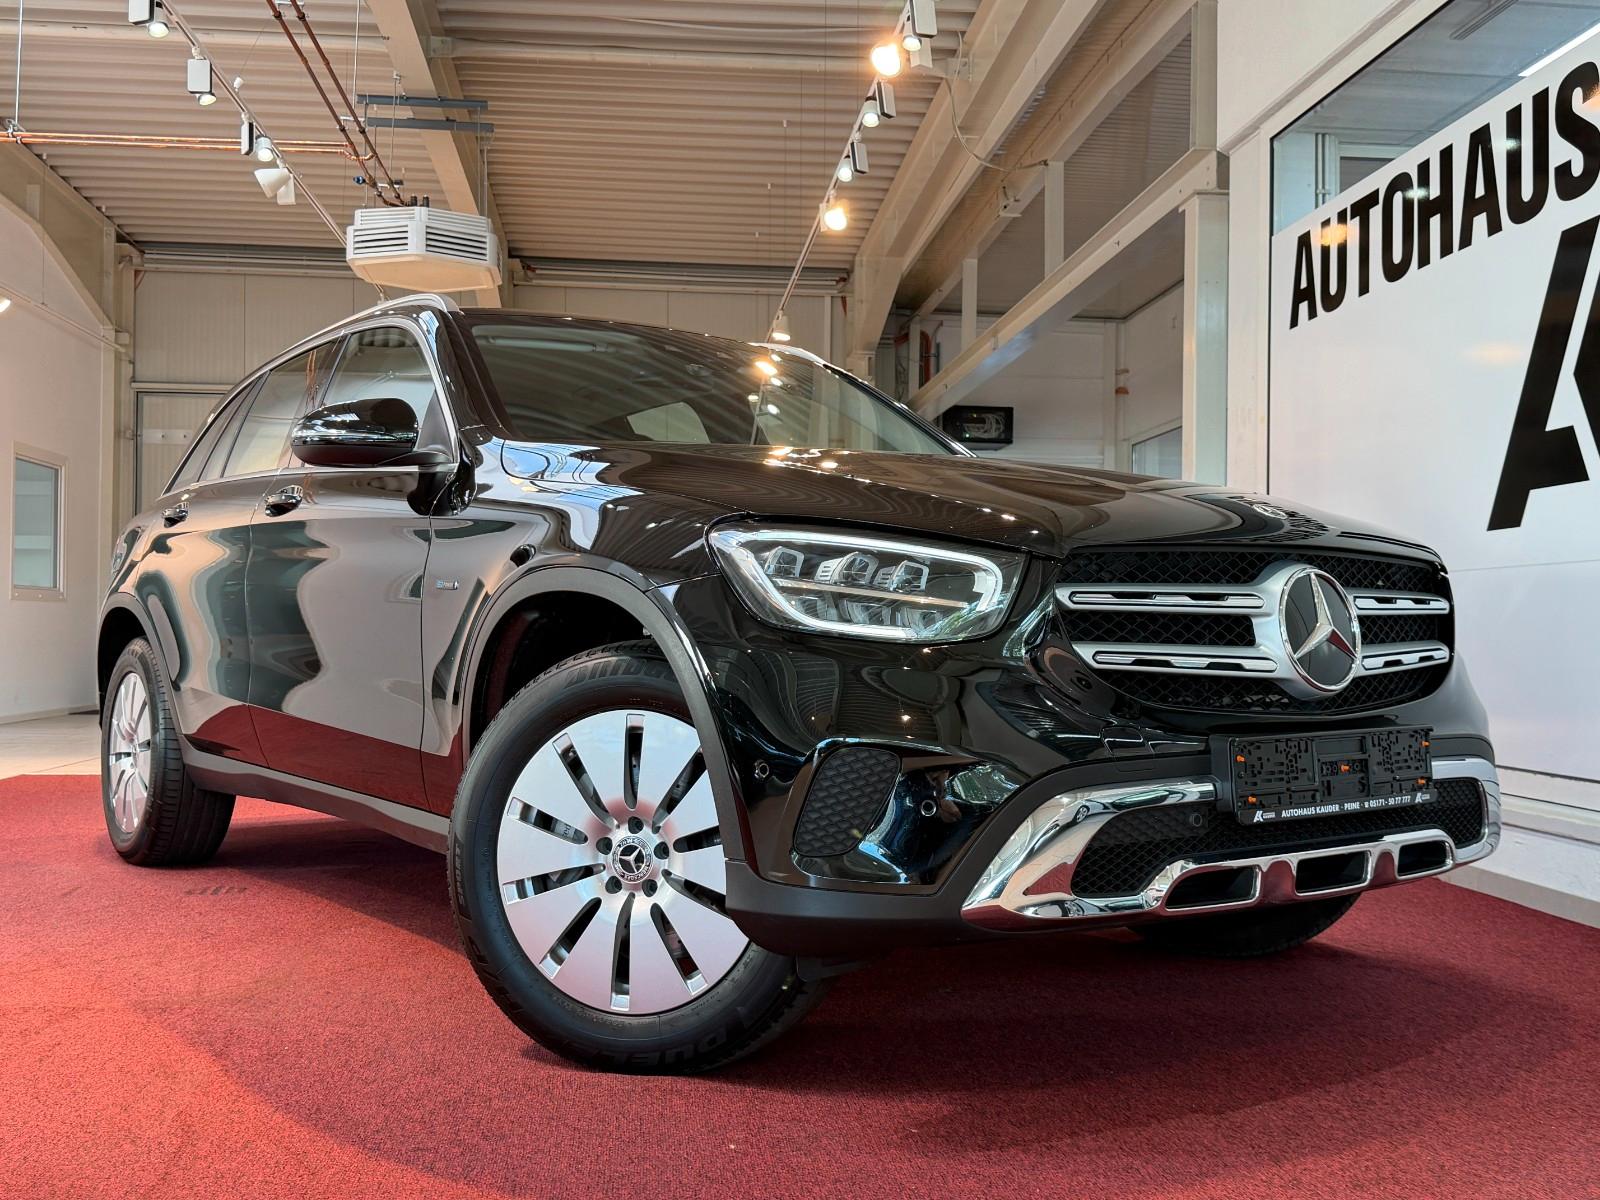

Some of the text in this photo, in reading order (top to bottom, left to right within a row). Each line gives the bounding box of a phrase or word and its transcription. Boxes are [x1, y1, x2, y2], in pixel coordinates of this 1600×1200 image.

[1289, 61, 1600, 330] AUTOHAUS
[1281, 807, 1316, 818] AUTOHAUS
[1316, 804, 1340, 814] KAUDER
[1344, 801, 1360, 811] PEINE
